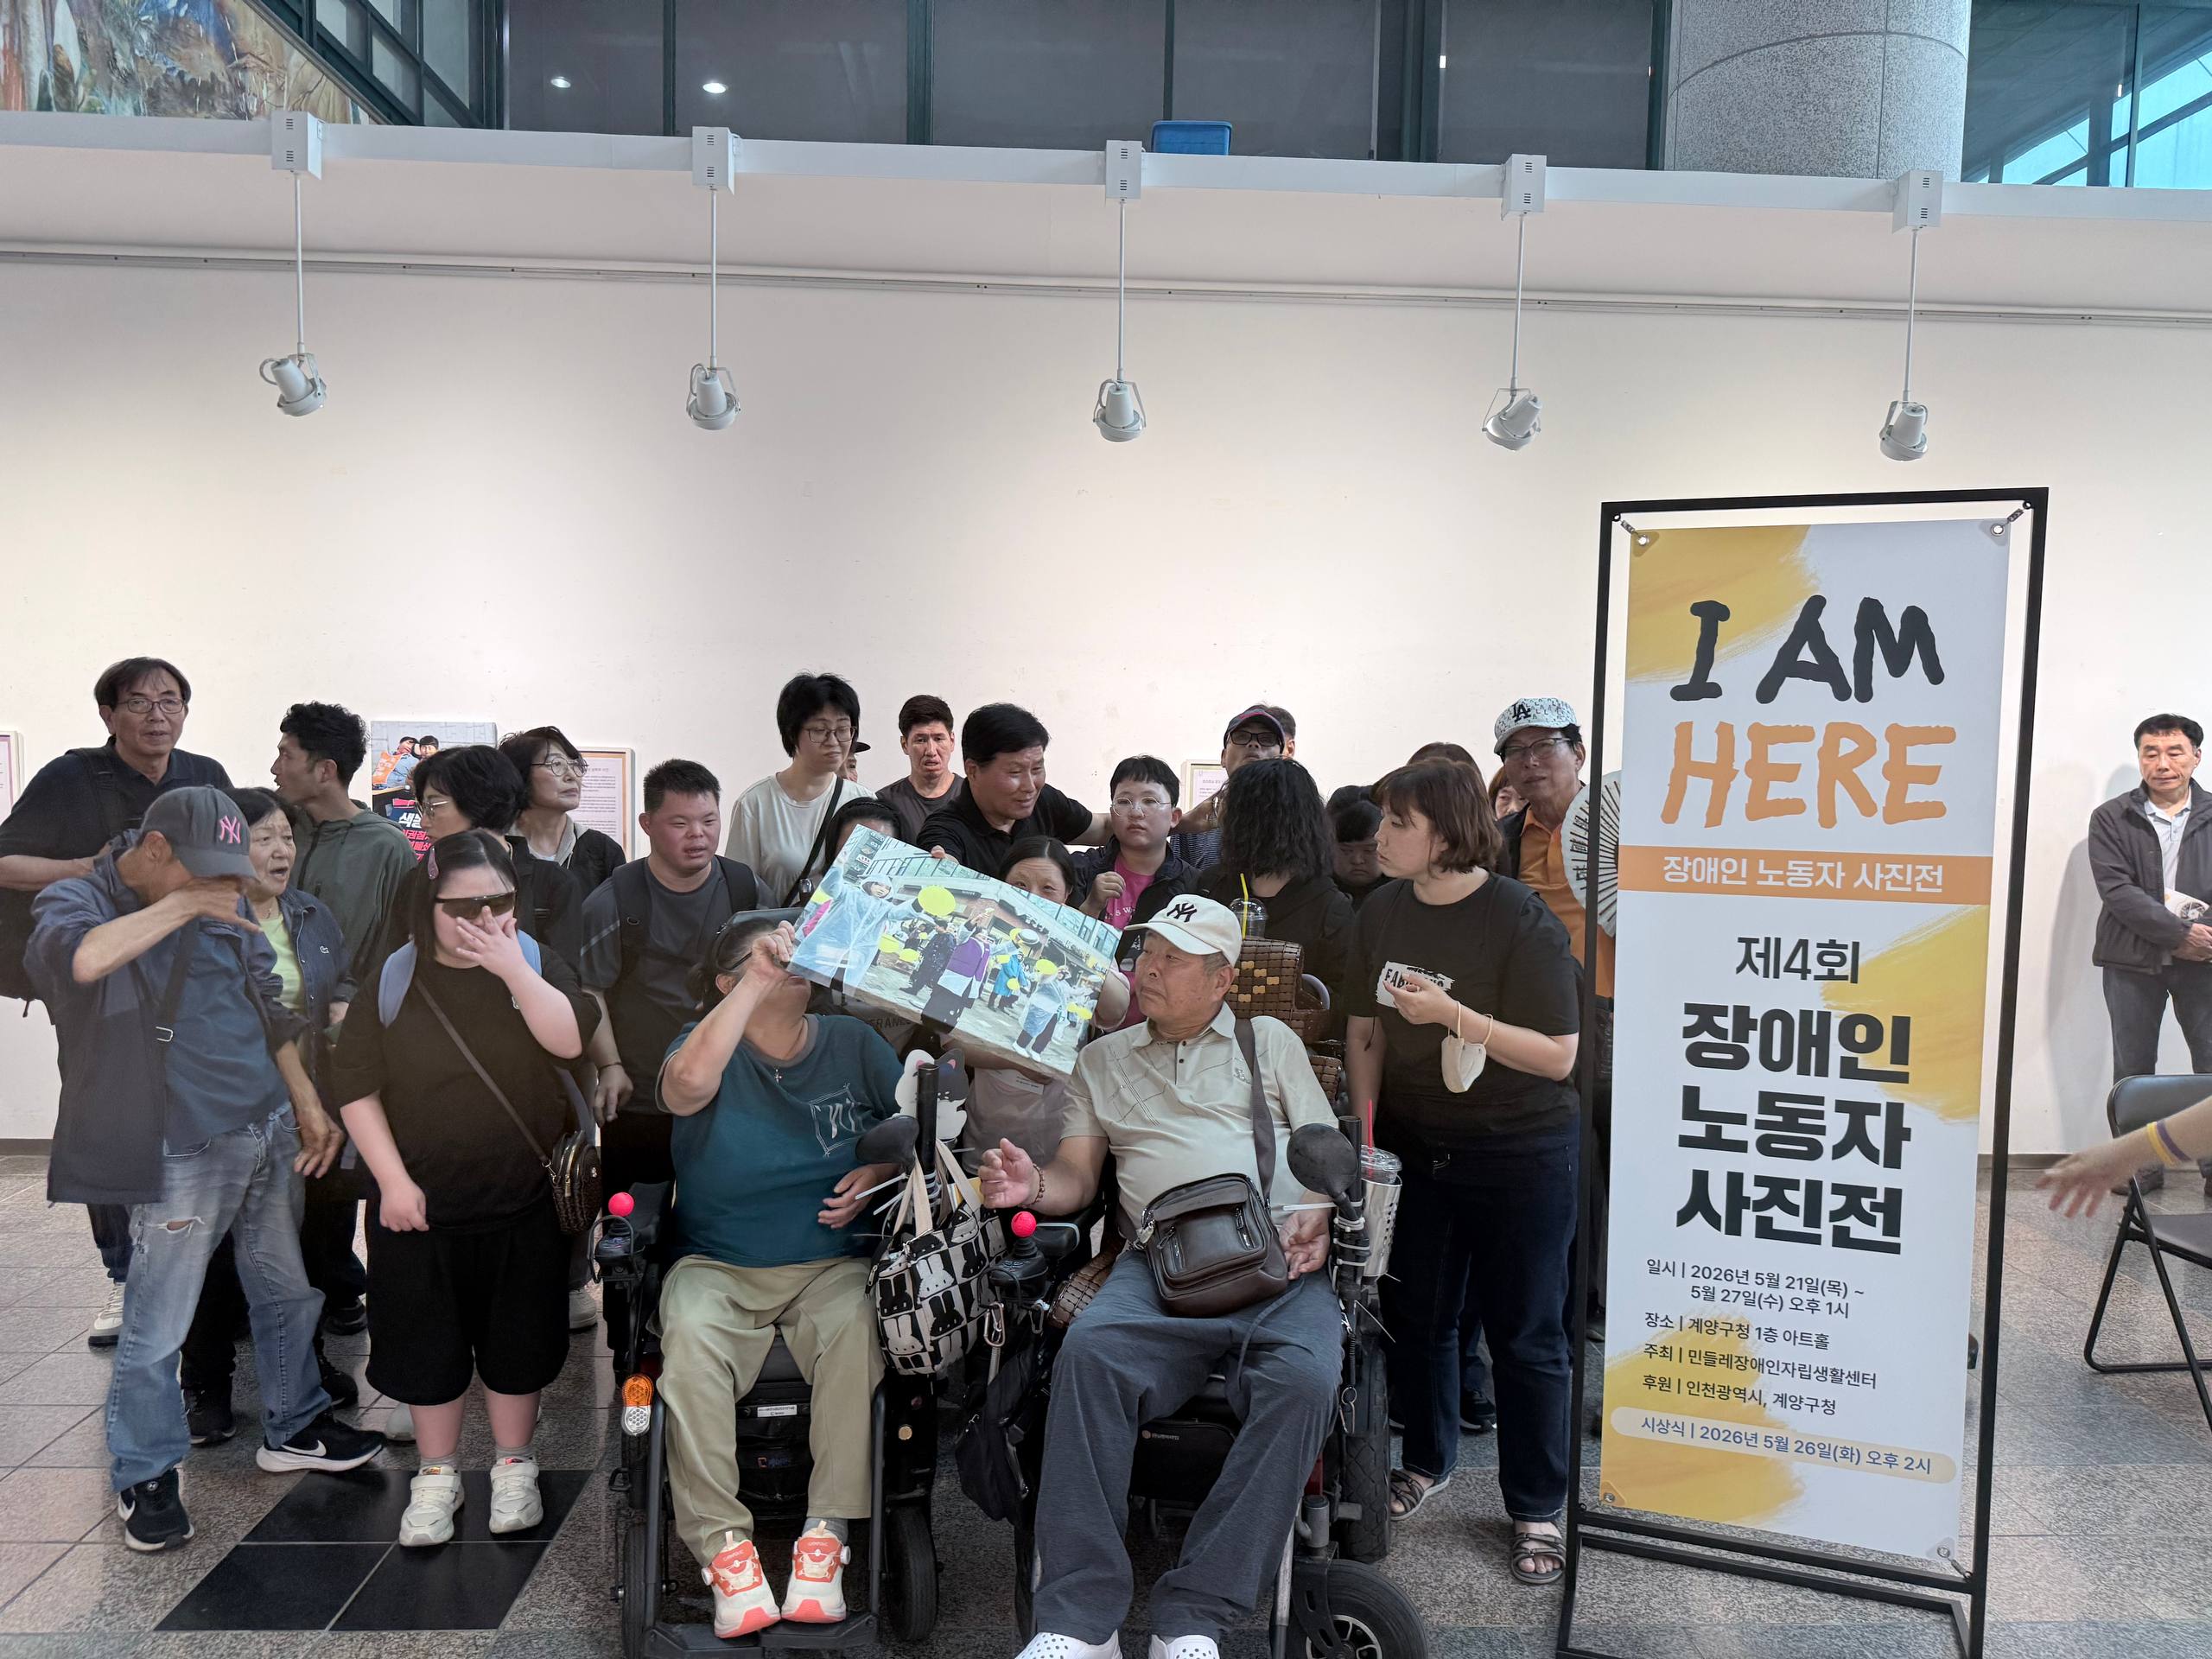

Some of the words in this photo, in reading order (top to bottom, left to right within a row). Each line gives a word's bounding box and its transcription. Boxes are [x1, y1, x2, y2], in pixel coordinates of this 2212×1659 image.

[1670, 601, 1730, 701] I
[1756, 595, 1944, 703] AM
[1512, 702, 1531, 722] LA
[1662, 721, 1955, 829] HERE
[219, 815, 241, 844] NY
[1664, 856, 1746, 885] 장애인
[1757, 860, 1845, 888] 노동자
[1853, 863, 1942, 893] 사진전
[1166, 903, 1198, 923] NY
[1737, 938, 1859, 983] 제4회
[1683, 1003, 1910, 1084] 장애인
[1679, 1085, 1910, 1169] 노동자
[1676, 1170, 1902, 1255] 사진전
[1647, 1259, 1675, 1277] 일시
[1691, 1265, 1749, 1285] 2026년
[1755, 1273, 1779, 1288] 5월
[1785, 1276, 1847, 1299] 21일(목)
[1691, 1286, 1715, 1301] 5월
[1721, 1289, 1783, 1312] 27일(수)
[1789, 1297, 1821, 1314] 오후
[1826, 1302, 1848, 1319] 1시
[1645, 1313, 1675, 1328] 장소
[1688, 1319, 1750, 1339] 계양구청
[1756, 1327, 1778, 1343] 1층
[1783, 1330, 1829, 1350] 아트홀
[1643, 1344, 1673, 1362] 주최
[1688, 1350, 1876, 1389] 민들레장애인자립생활센터
[1643, 1375, 1671, 1392] 후원
[1687, 1381, 1767, 1408] 인천광역시,
[1773, 1393, 1835, 1415] 계양구청
[1642, 1417, 1684, 1437] 시상식
[1700, 1427, 1758, 1447] 2026년
[1764, 1435, 1788, 1452] 5월
[1794, 1440, 1860, 1465] 26일(화)
[1866, 1451, 1898, 1469] 오후
[1904, 1457, 1930, 1475] 2시
